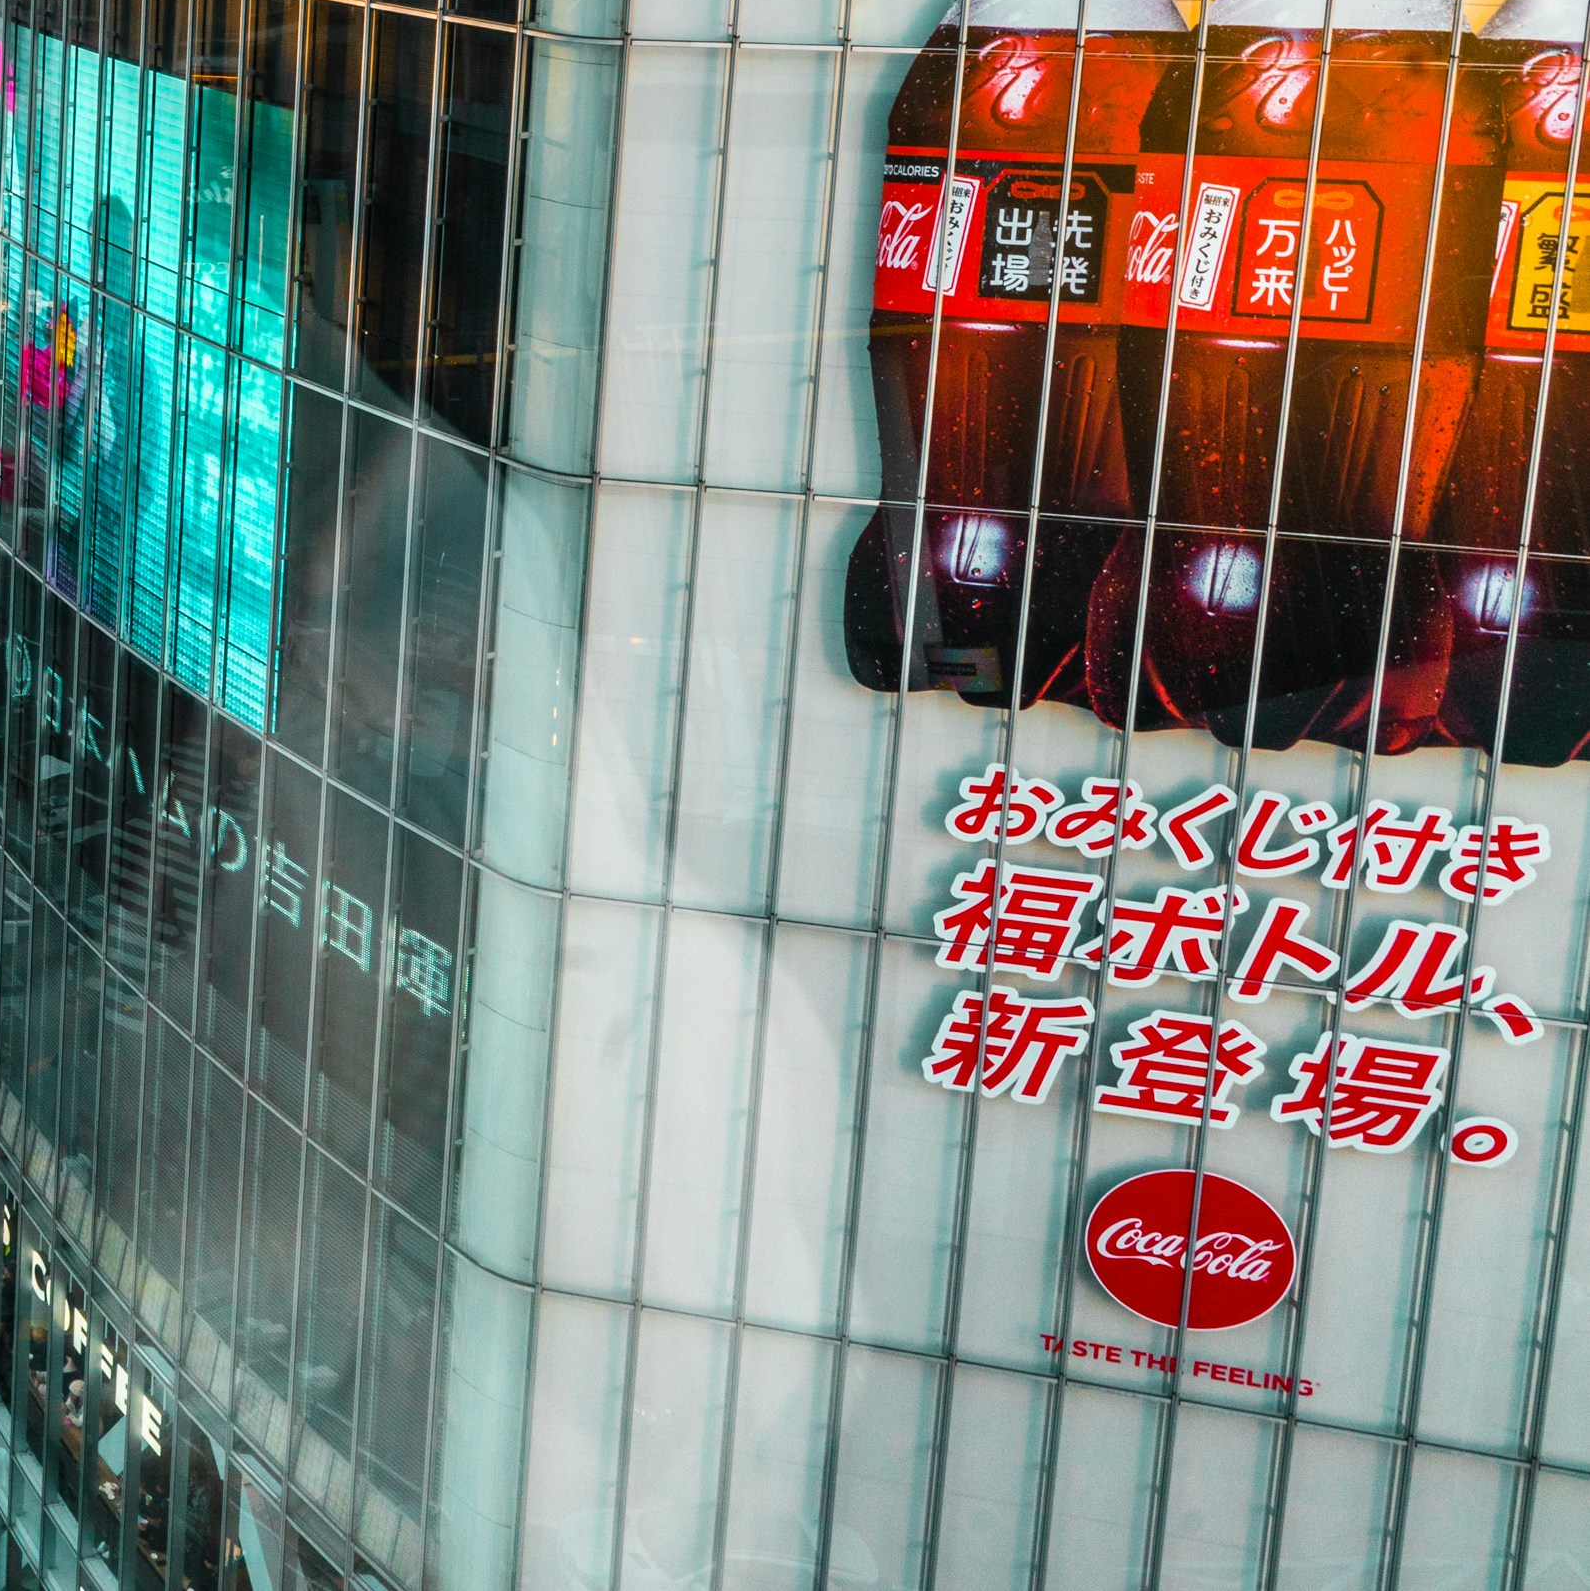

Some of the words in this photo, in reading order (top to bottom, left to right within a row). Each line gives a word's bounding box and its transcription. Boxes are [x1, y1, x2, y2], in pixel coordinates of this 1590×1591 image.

[893, 166, 939, 177] CALORIES
[1204, 194, 1231, 208] 福招来
[991, 207, 1033, 294] 出場
[1189, 209, 1223, 300] おみくじ付き
[1251, 215, 1297, 307] 万来
[1322, 218, 1356, 311] ハッピー
[951, 767, 1545, 901] おみくじ付き
[937, 861, 1541, 1041] 福ボトル、
[927, 990, 1513, 1165] 新登場。
[1096, 1217, 1286, 1282] CocaCola
[1193, 1361, 1314, 1397] FEELING
